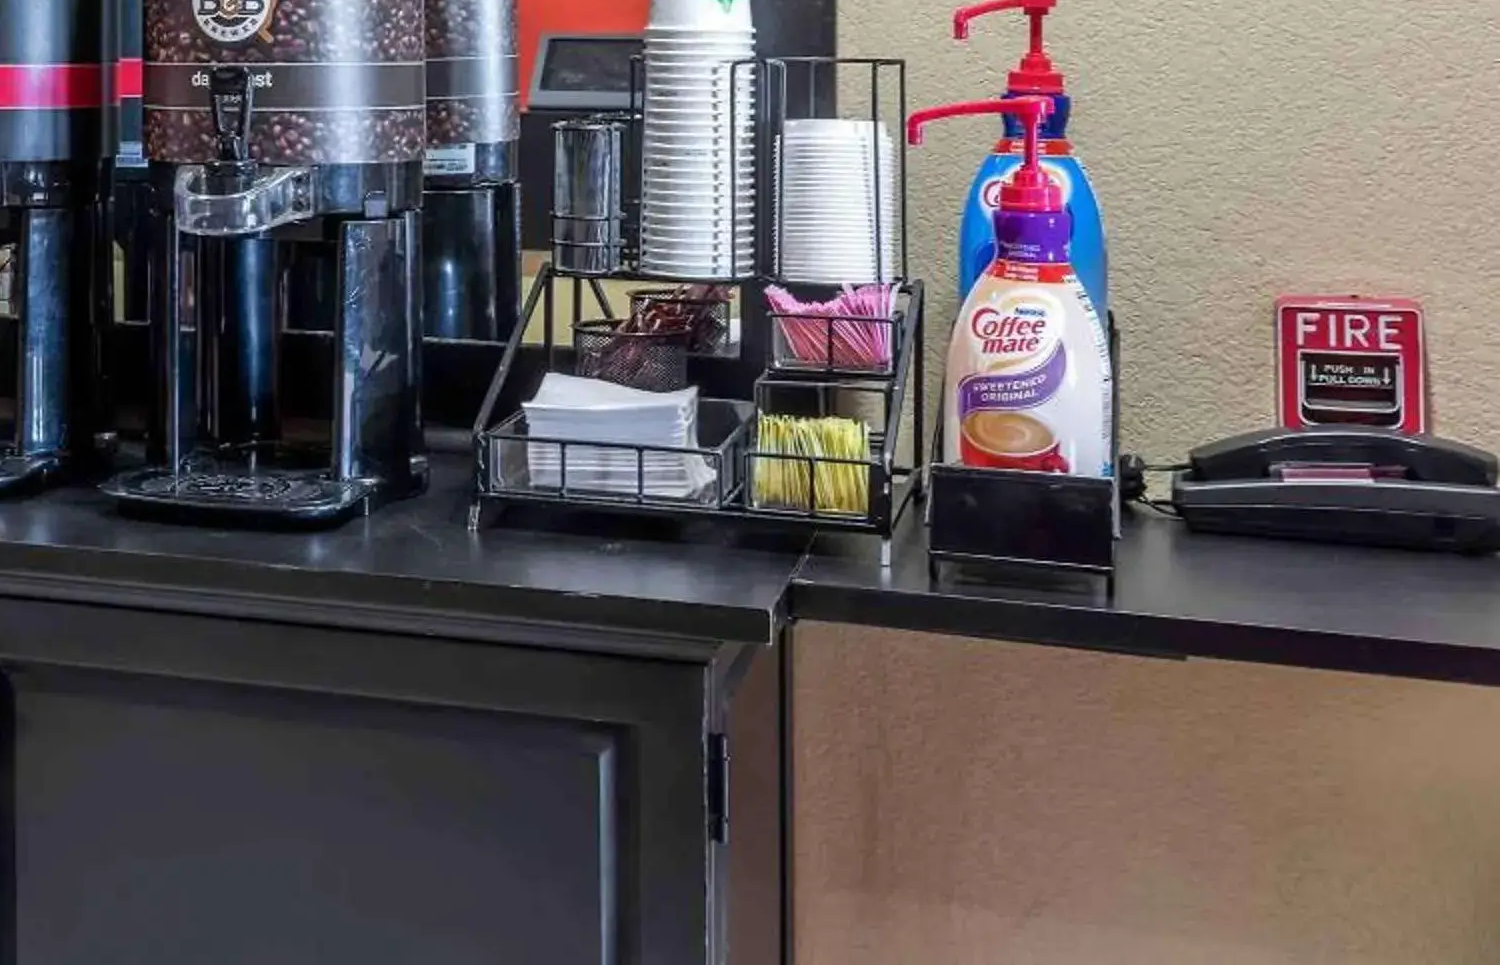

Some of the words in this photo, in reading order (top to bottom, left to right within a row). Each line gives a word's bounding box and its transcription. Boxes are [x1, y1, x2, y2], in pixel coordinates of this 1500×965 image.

[971, 307, 1046, 340] Coffee
[1296, 312, 1404, 350] FIRE
[981, 335, 1041, 354] mate
[1323, 364, 1354, 374] PUSH
[1363, 366, 1375, 374] IN
[980, 390, 1038, 403] ORIGINAL
